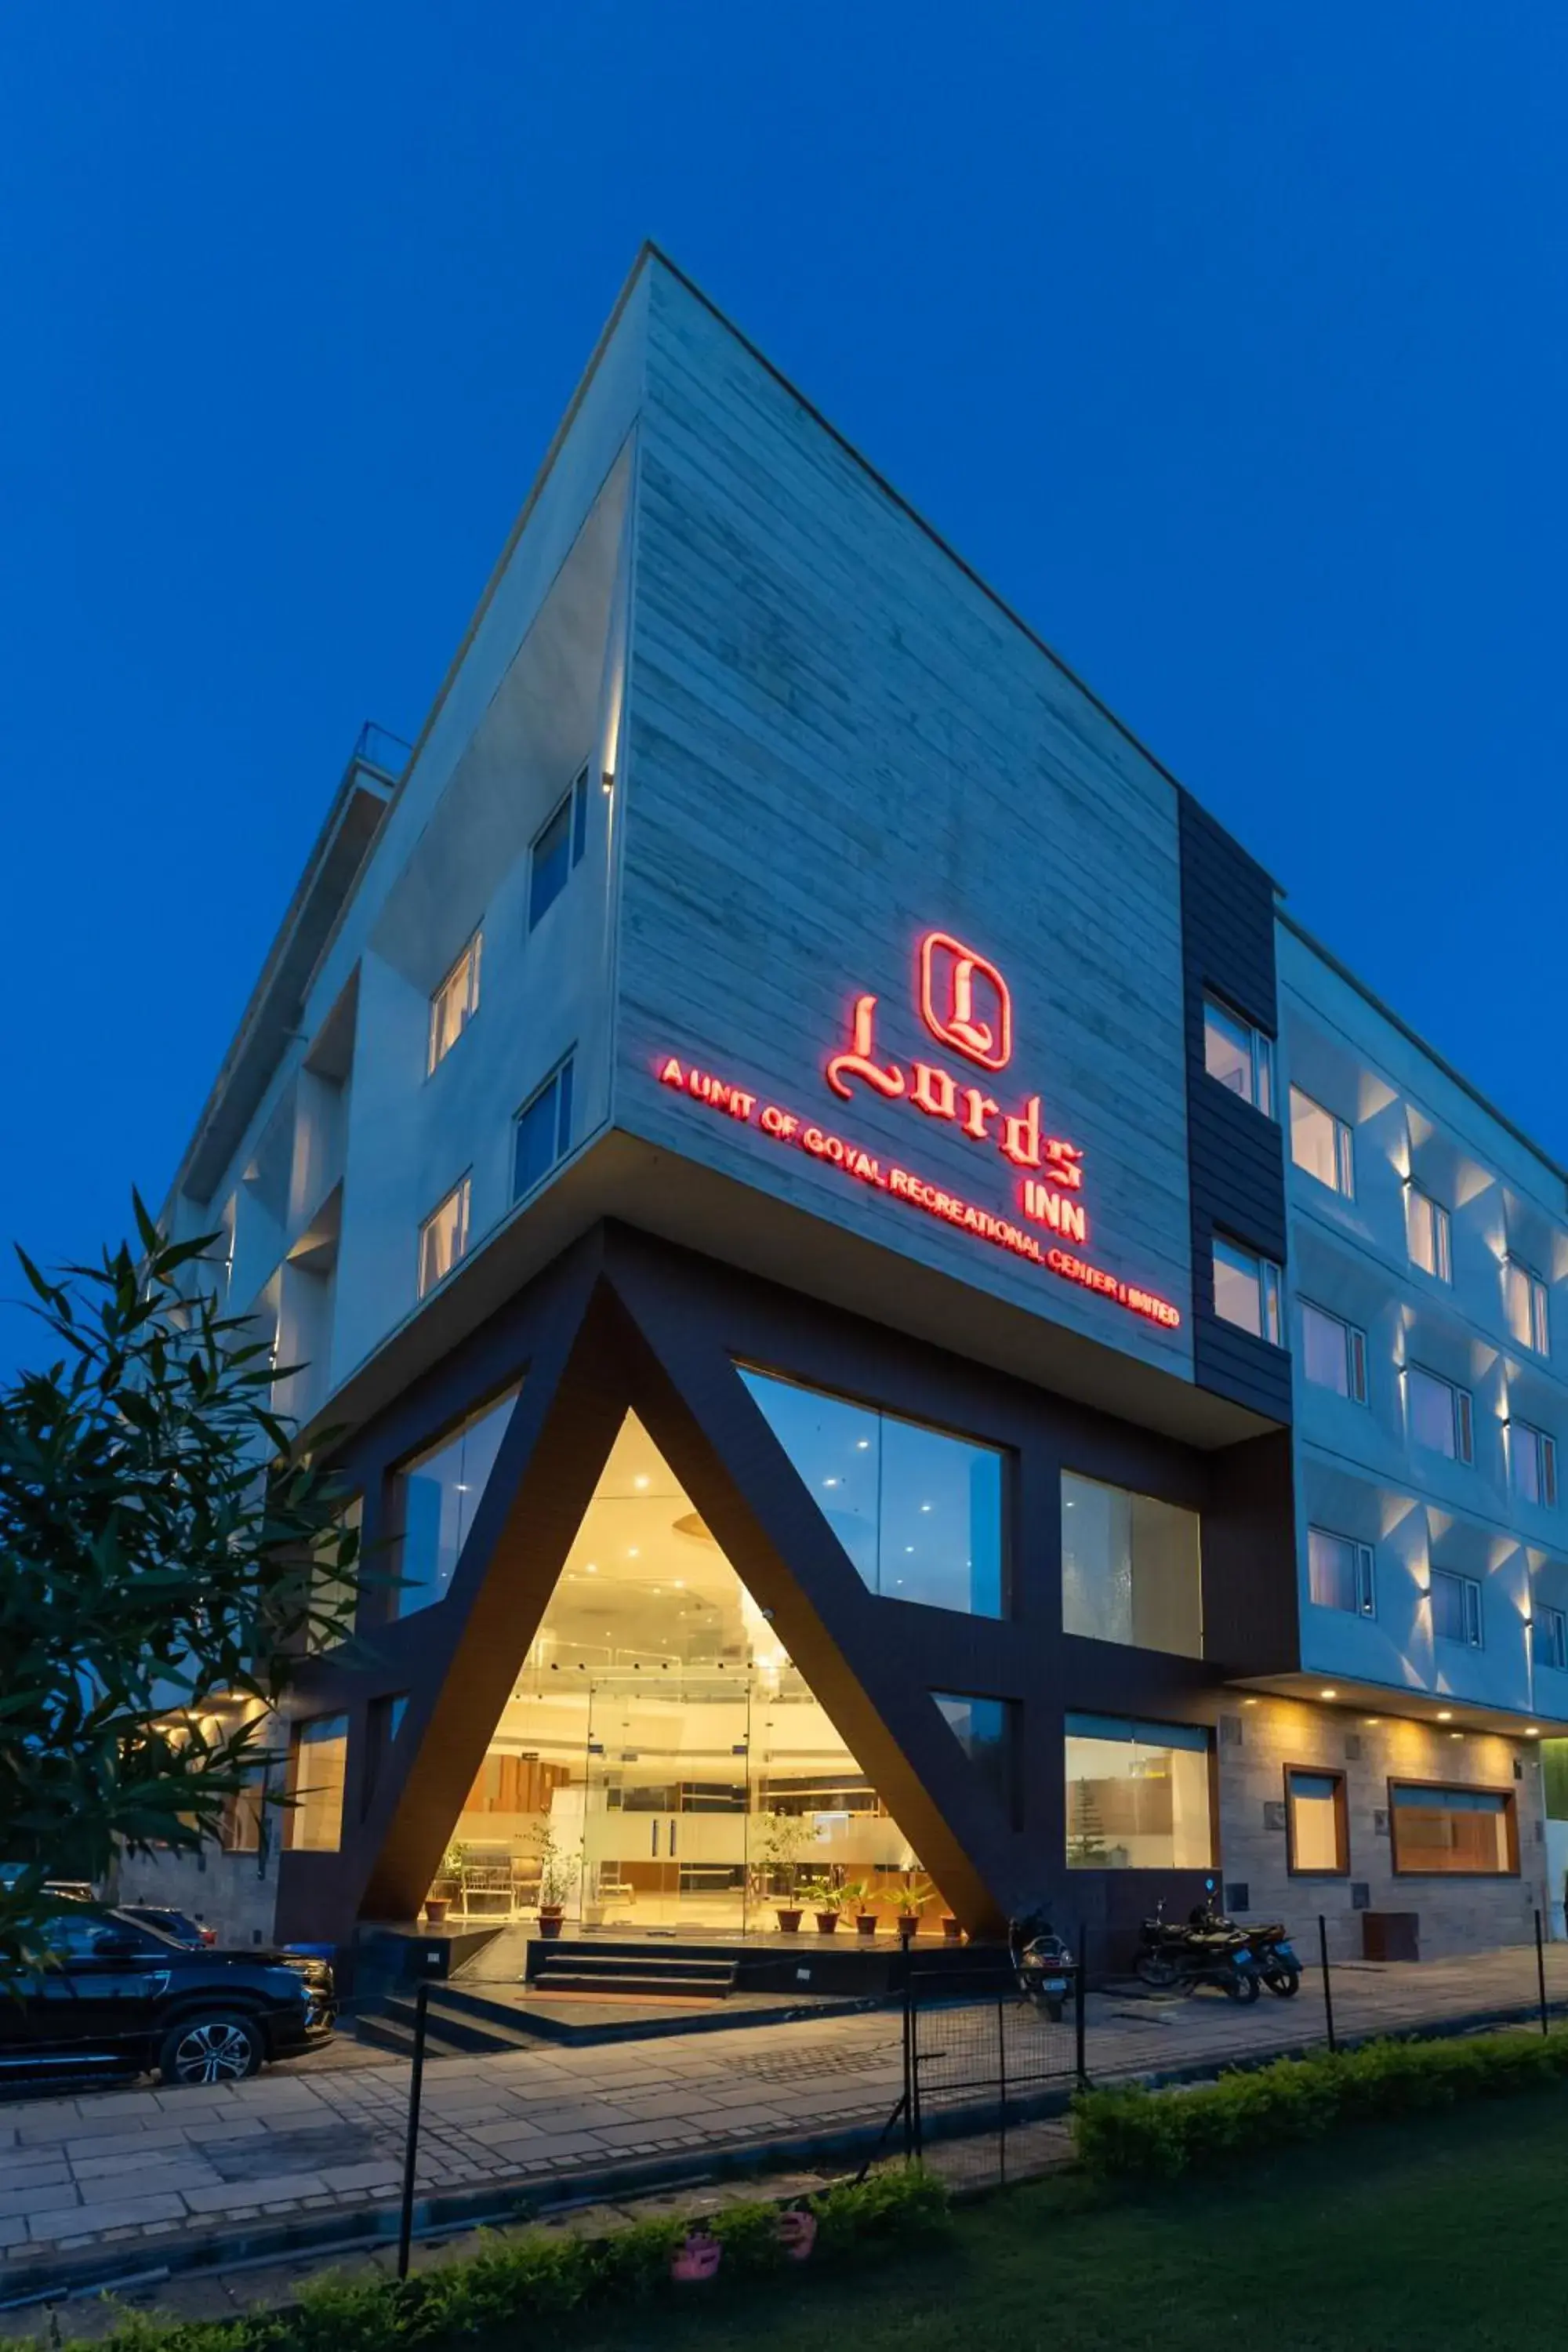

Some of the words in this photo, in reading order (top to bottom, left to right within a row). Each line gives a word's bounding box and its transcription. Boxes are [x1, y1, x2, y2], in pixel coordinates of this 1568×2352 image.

[948, 958, 994, 1054] L
[827, 994, 1083, 1189] Lords
[662, 1058, 684, 1088] A
[689, 1069, 757, 1120] UNIT
[760, 1106, 800, 1141] OF
[802, 1127, 886, 1187] GOYAL
[889, 1168, 1045, 1264] RECREATIONAL
[1045, 1248, 1118, 1300] CENTER
[1023, 1179, 1086, 1242] INN
